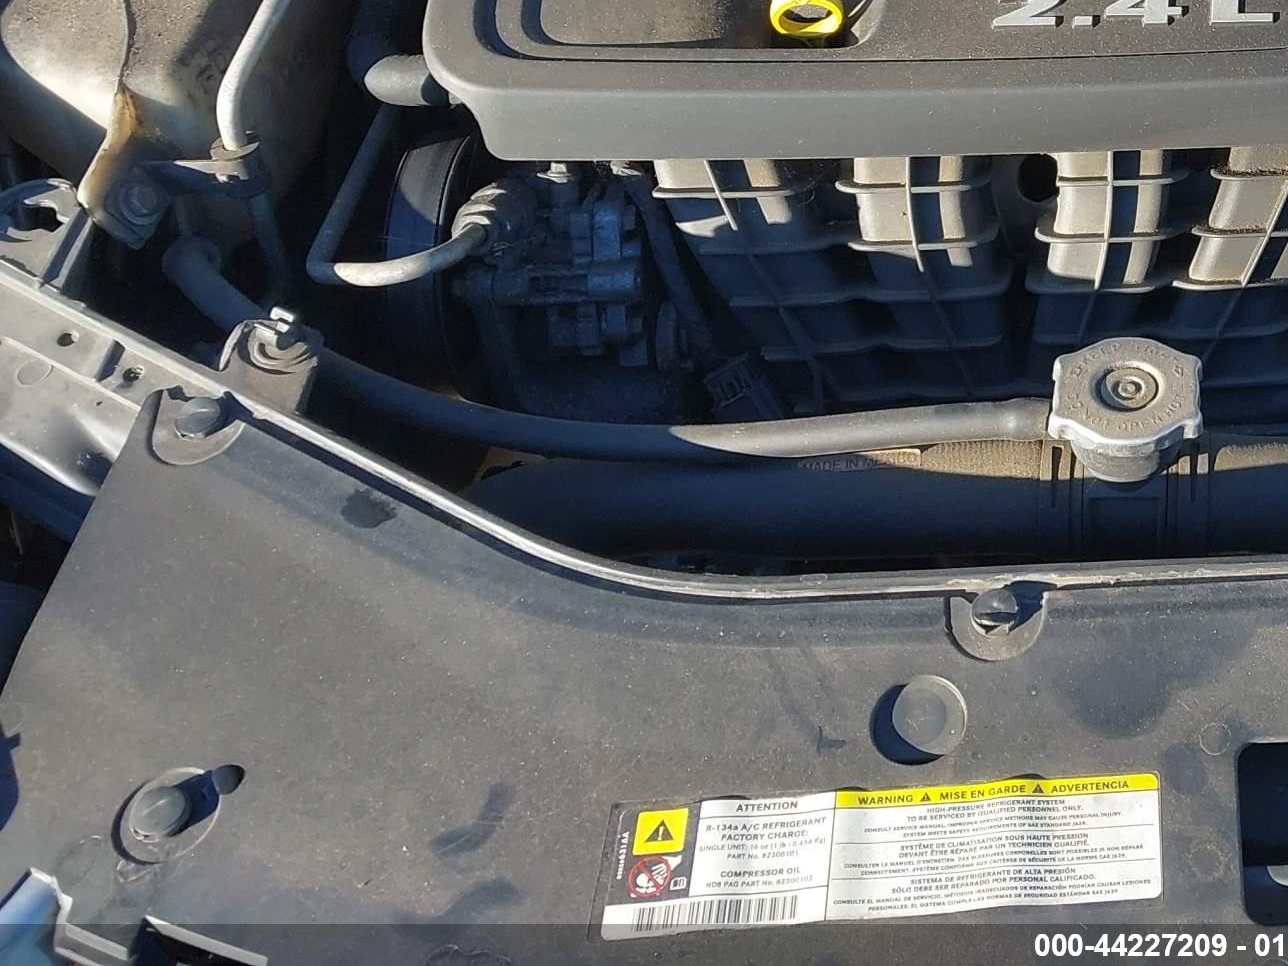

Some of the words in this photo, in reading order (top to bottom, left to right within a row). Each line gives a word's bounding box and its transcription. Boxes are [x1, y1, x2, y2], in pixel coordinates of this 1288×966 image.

[858, 794, 914, 805] WARNING
[940, 790, 968, 800] MISE
[970, 790, 984, 798] EN
[988, 785, 1026, 796] GARDE
[1051, 780, 1129, 793] ADVERTENCIA
[736, 801, 798, 812] ATTENTION
[927, 805, 984, 813] HIGH-PRESSURE
[987, 799, 1036, 808] REFRIGERANT
[978, 807, 1016, 816] QUALIFIED
[706, 823, 738, 832] R-134a
[741, 823, 760, 833] A/C
[762, 816, 827, 830] REFRIGERANT
[721, 833, 765, 841] FACTORY
[900, 842, 934, 851] SYSTÈME
[947, 836, 1002, 848] CLIMATISATION
[720, 868, 784, 878] COMPRESSOR
[910, 877, 942, 885] SISTEMA
[956, 869, 1011, 881] REFRIGERANTE
[1044, 867, 1076, 875] PRESIÓN
[892, 886, 911, 894] SÓLO
[950, 879, 990, 889] REPARADO
